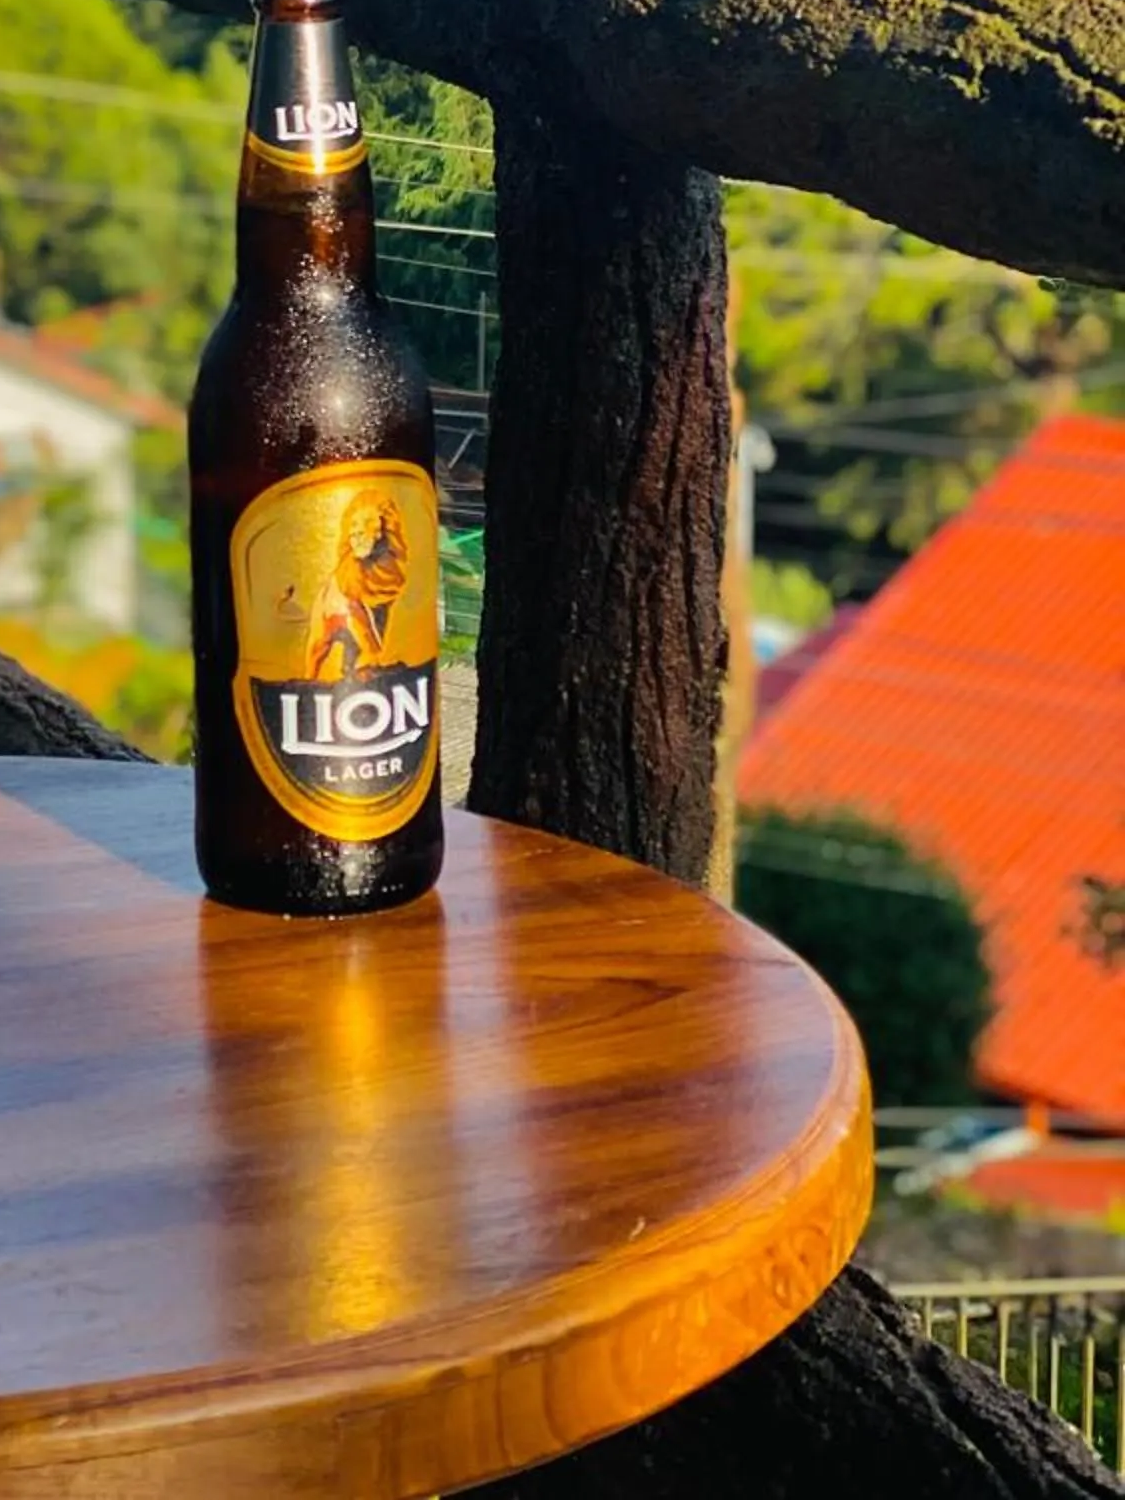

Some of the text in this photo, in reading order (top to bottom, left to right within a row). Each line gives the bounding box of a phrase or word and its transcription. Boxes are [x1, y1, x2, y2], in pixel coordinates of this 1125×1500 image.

[275, 101, 358, 141] LION
[280, 676, 430, 757] LION
[324, 759, 404, 782] LAGER
